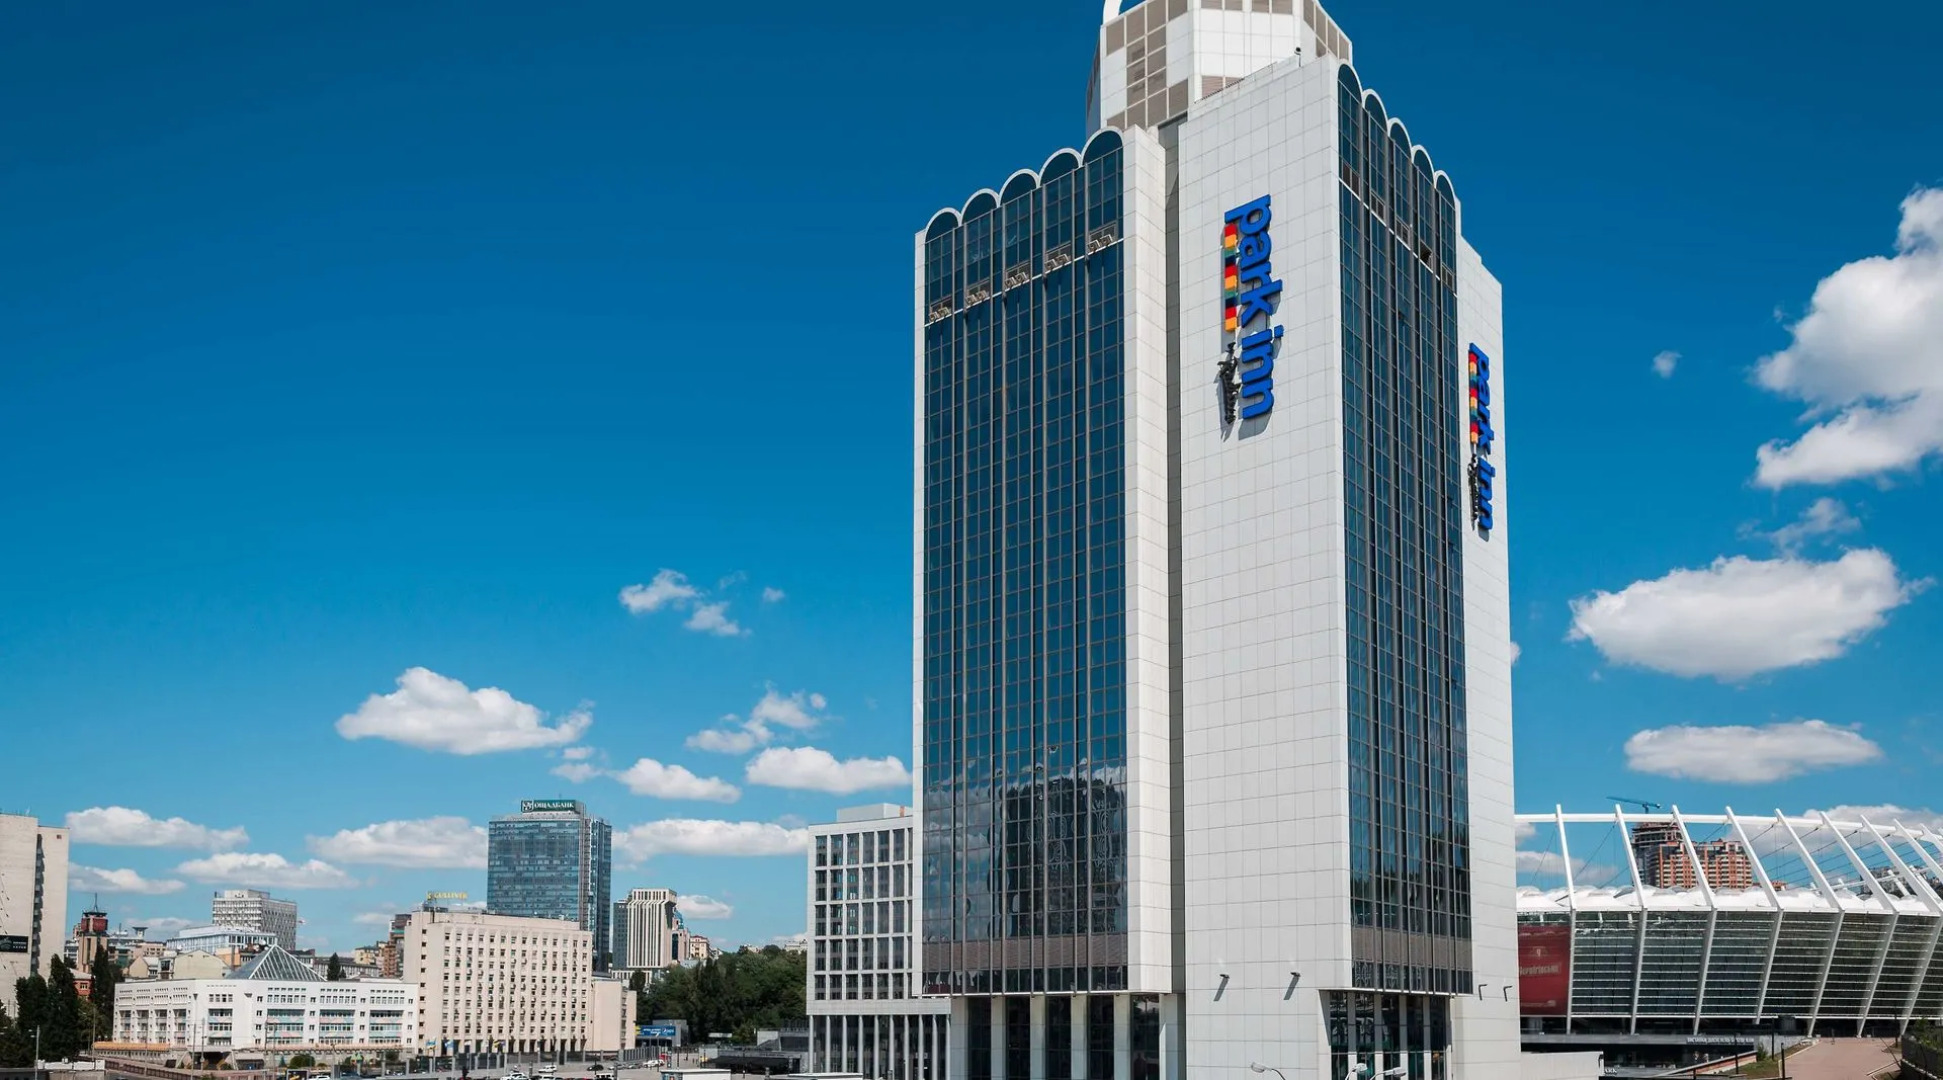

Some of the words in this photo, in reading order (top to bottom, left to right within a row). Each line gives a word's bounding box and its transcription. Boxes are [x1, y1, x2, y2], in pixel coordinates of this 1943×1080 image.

[1224, 194, 1283, 328] park
[1242, 324, 1284, 419] inn
[1469, 342, 1494, 455] park
[1478, 457, 1496, 530] inn
